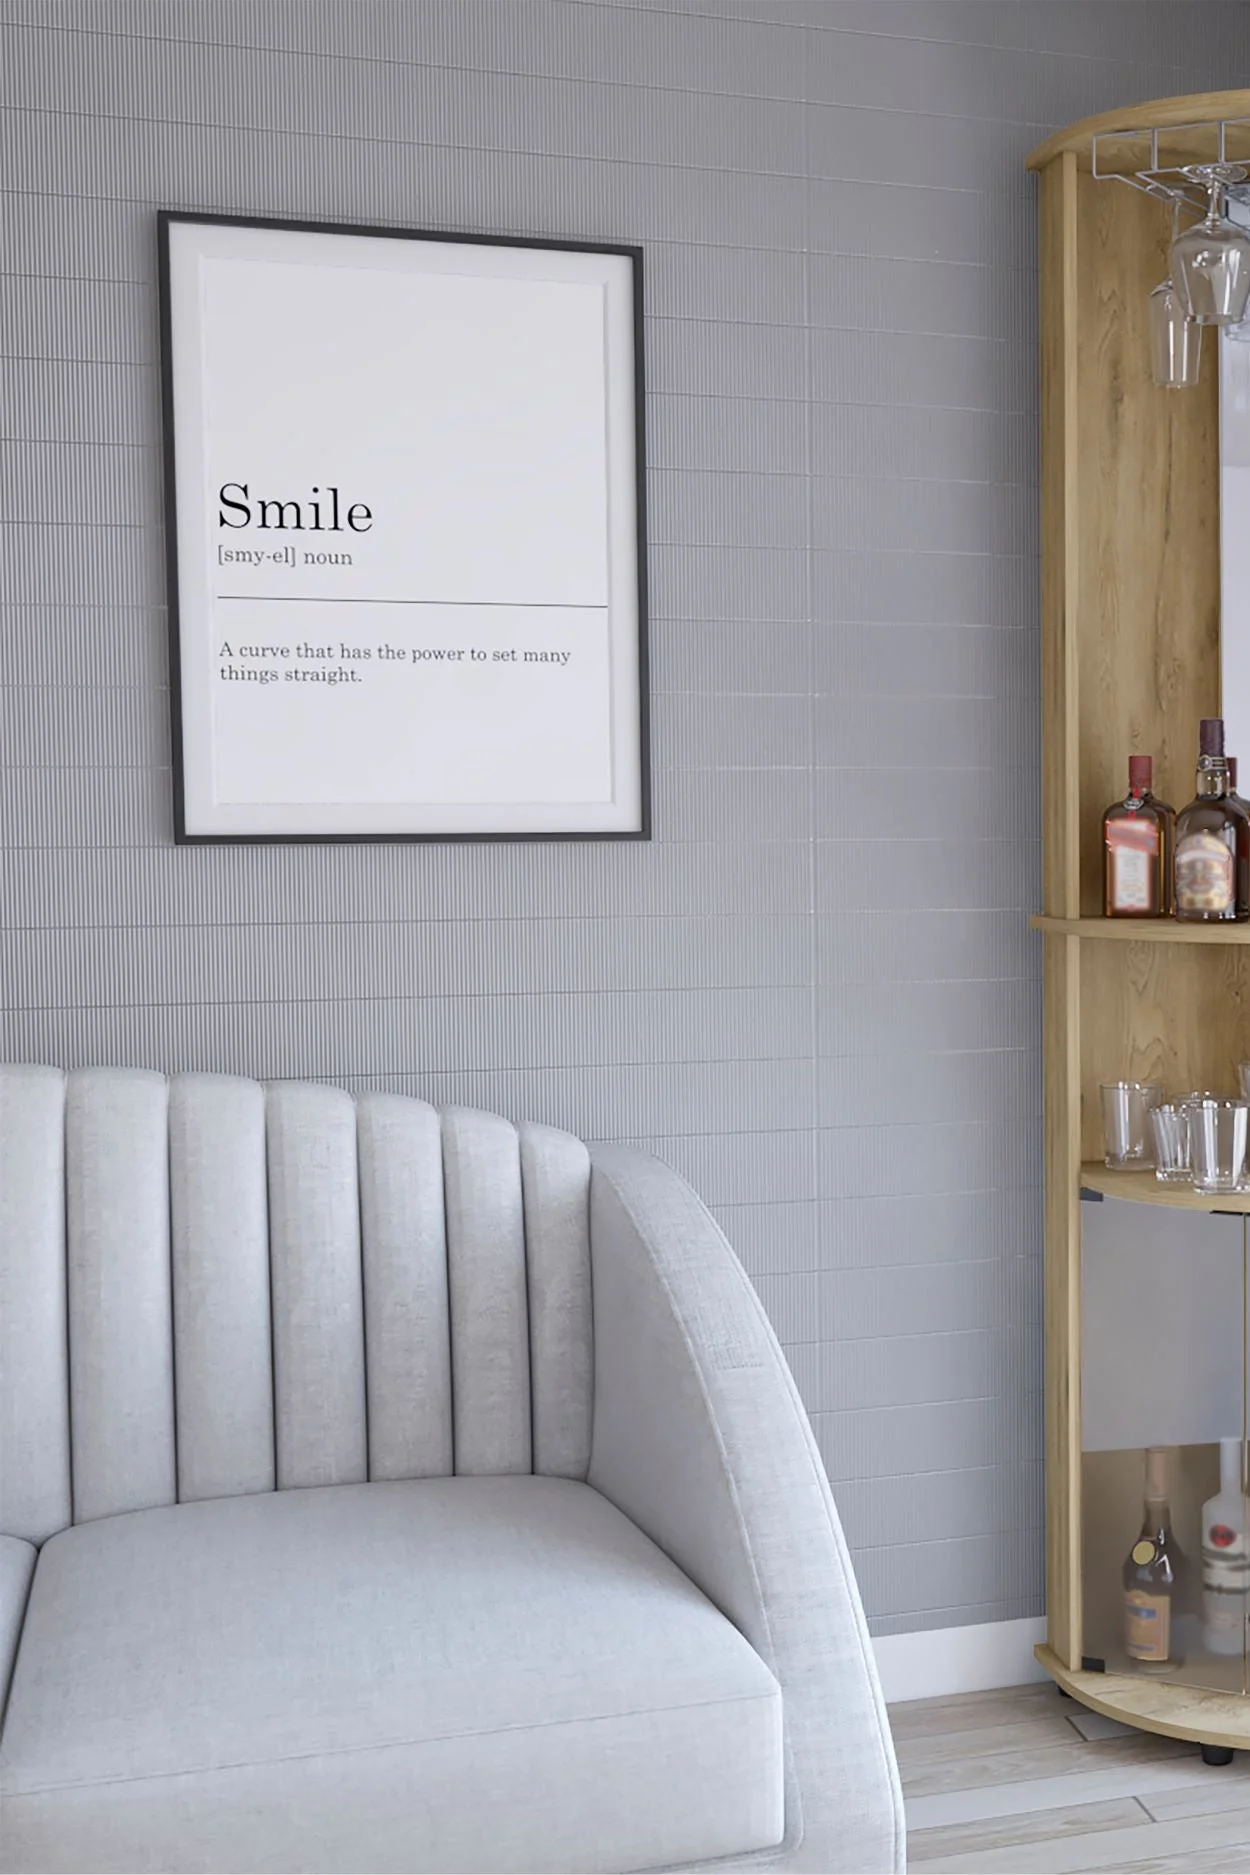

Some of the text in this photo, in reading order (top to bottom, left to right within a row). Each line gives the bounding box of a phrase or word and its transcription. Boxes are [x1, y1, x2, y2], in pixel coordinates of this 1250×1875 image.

[218, 482, 373, 533] Smile
[217, 544, 353, 568] [smy-el] noun
[219, 641, 571, 666] A curve that has the power to set many
[220, 664, 363, 686] things straight.
